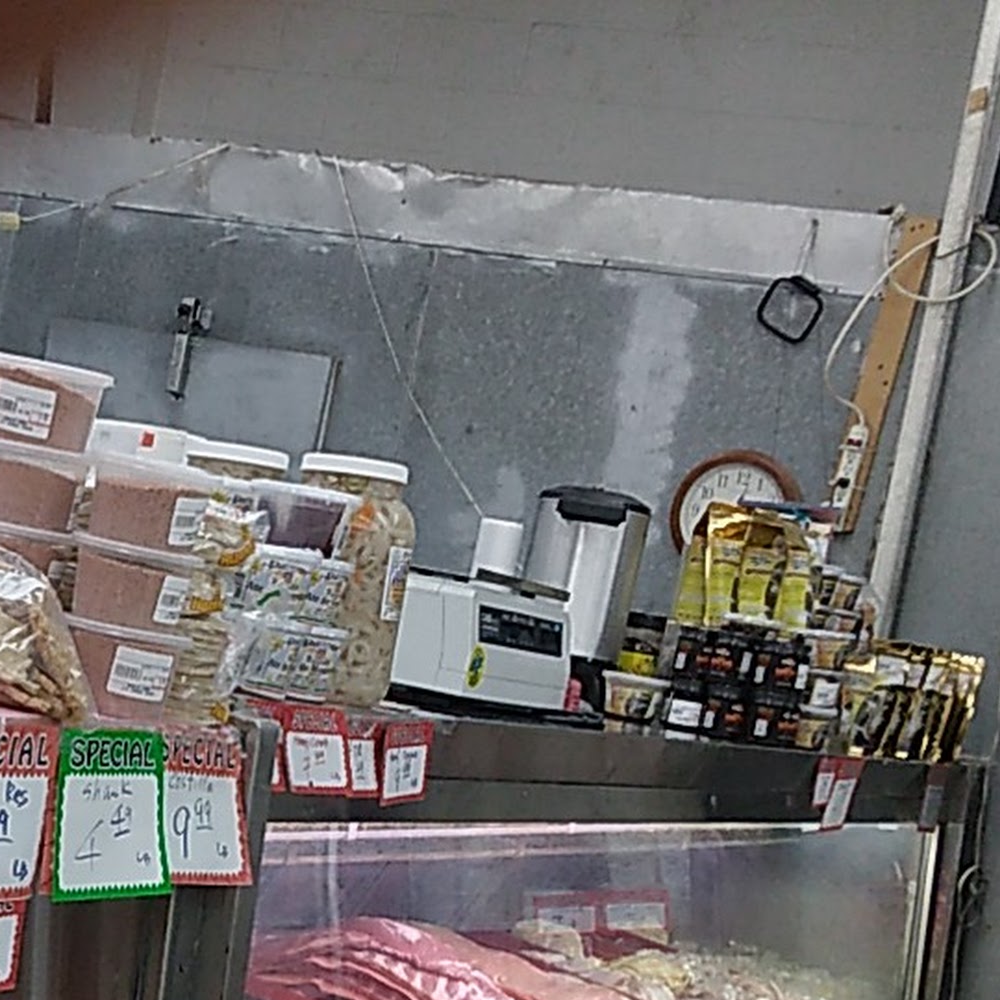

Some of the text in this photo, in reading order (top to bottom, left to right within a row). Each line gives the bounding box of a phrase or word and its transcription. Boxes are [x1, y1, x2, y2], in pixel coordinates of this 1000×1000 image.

[70, 738, 156, 768] SPECIAL
[73, 818, 104, 872] 4
[173, 805, 191, 859] 9
